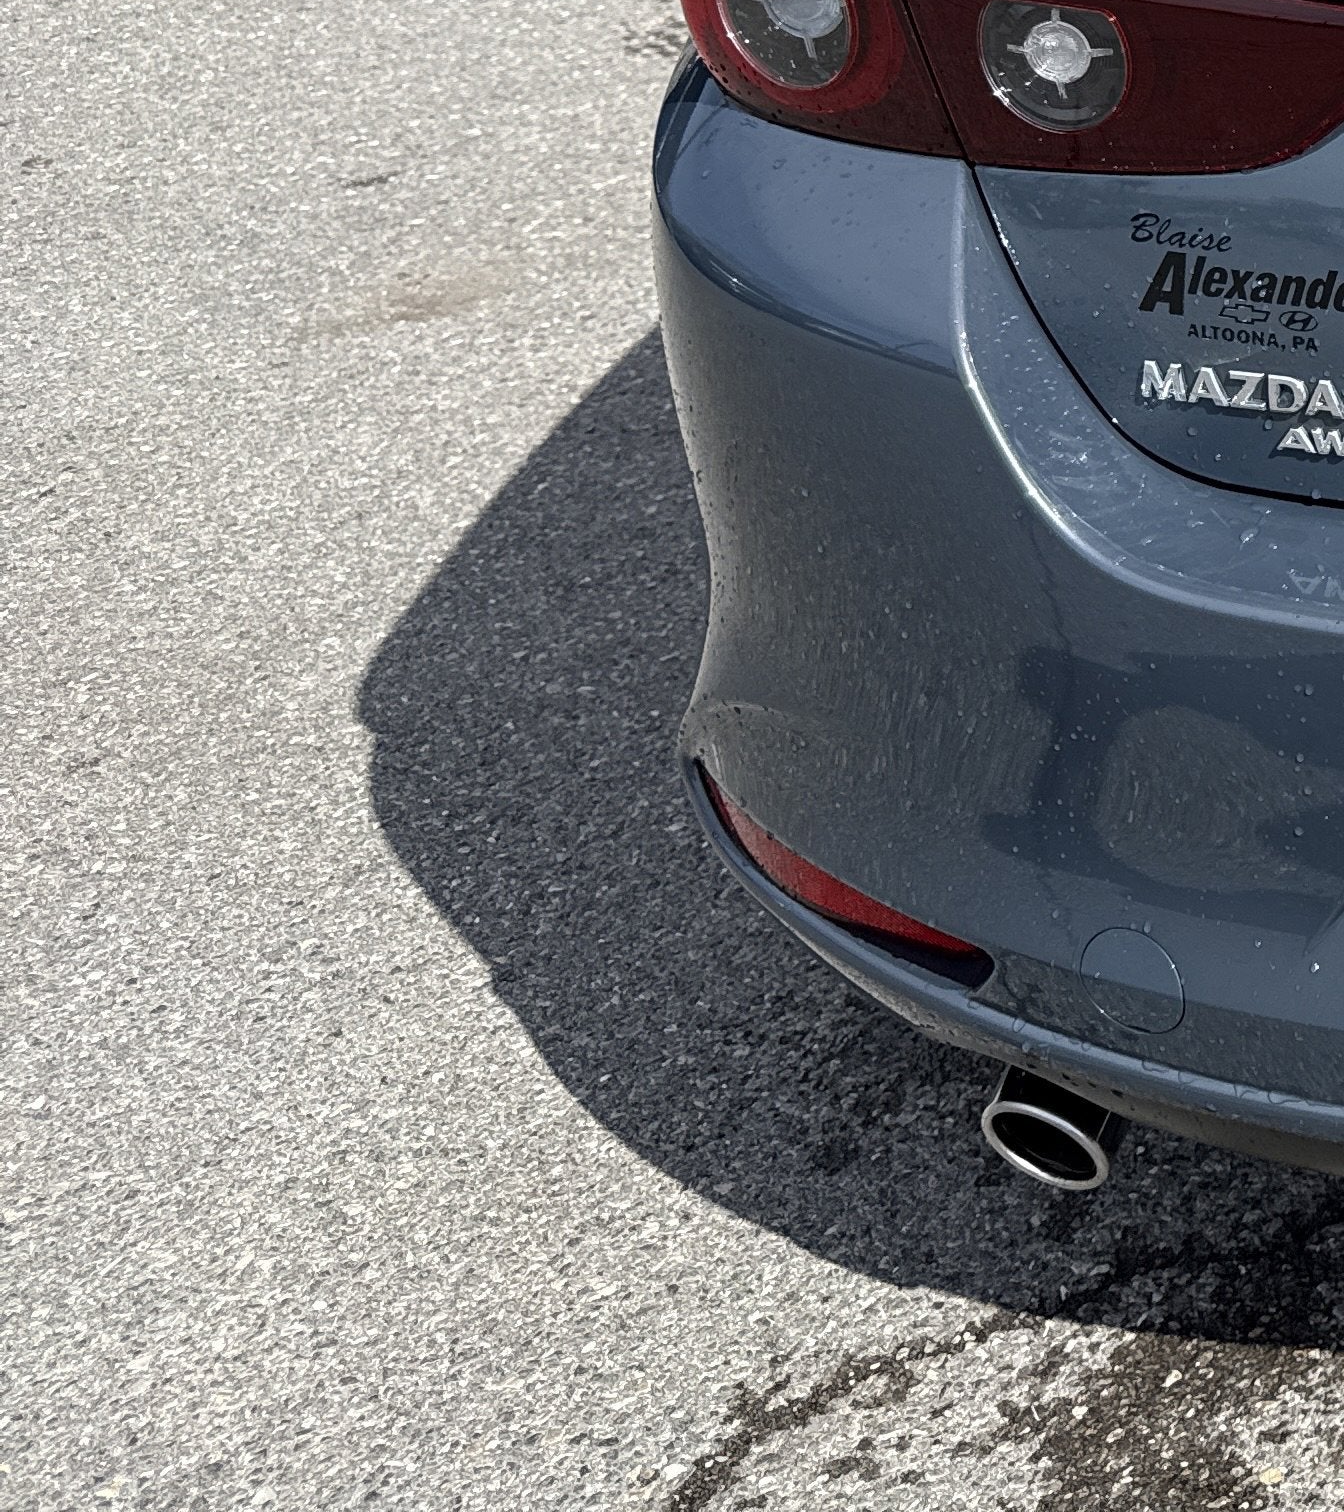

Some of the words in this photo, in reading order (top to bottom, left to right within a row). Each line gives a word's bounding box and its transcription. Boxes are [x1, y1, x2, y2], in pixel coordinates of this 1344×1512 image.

[1130, 213, 1232, 253] Blaise
[1187, 324, 1285, 352] ALTOONA,
[1292, 336, 1319, 352] PA
